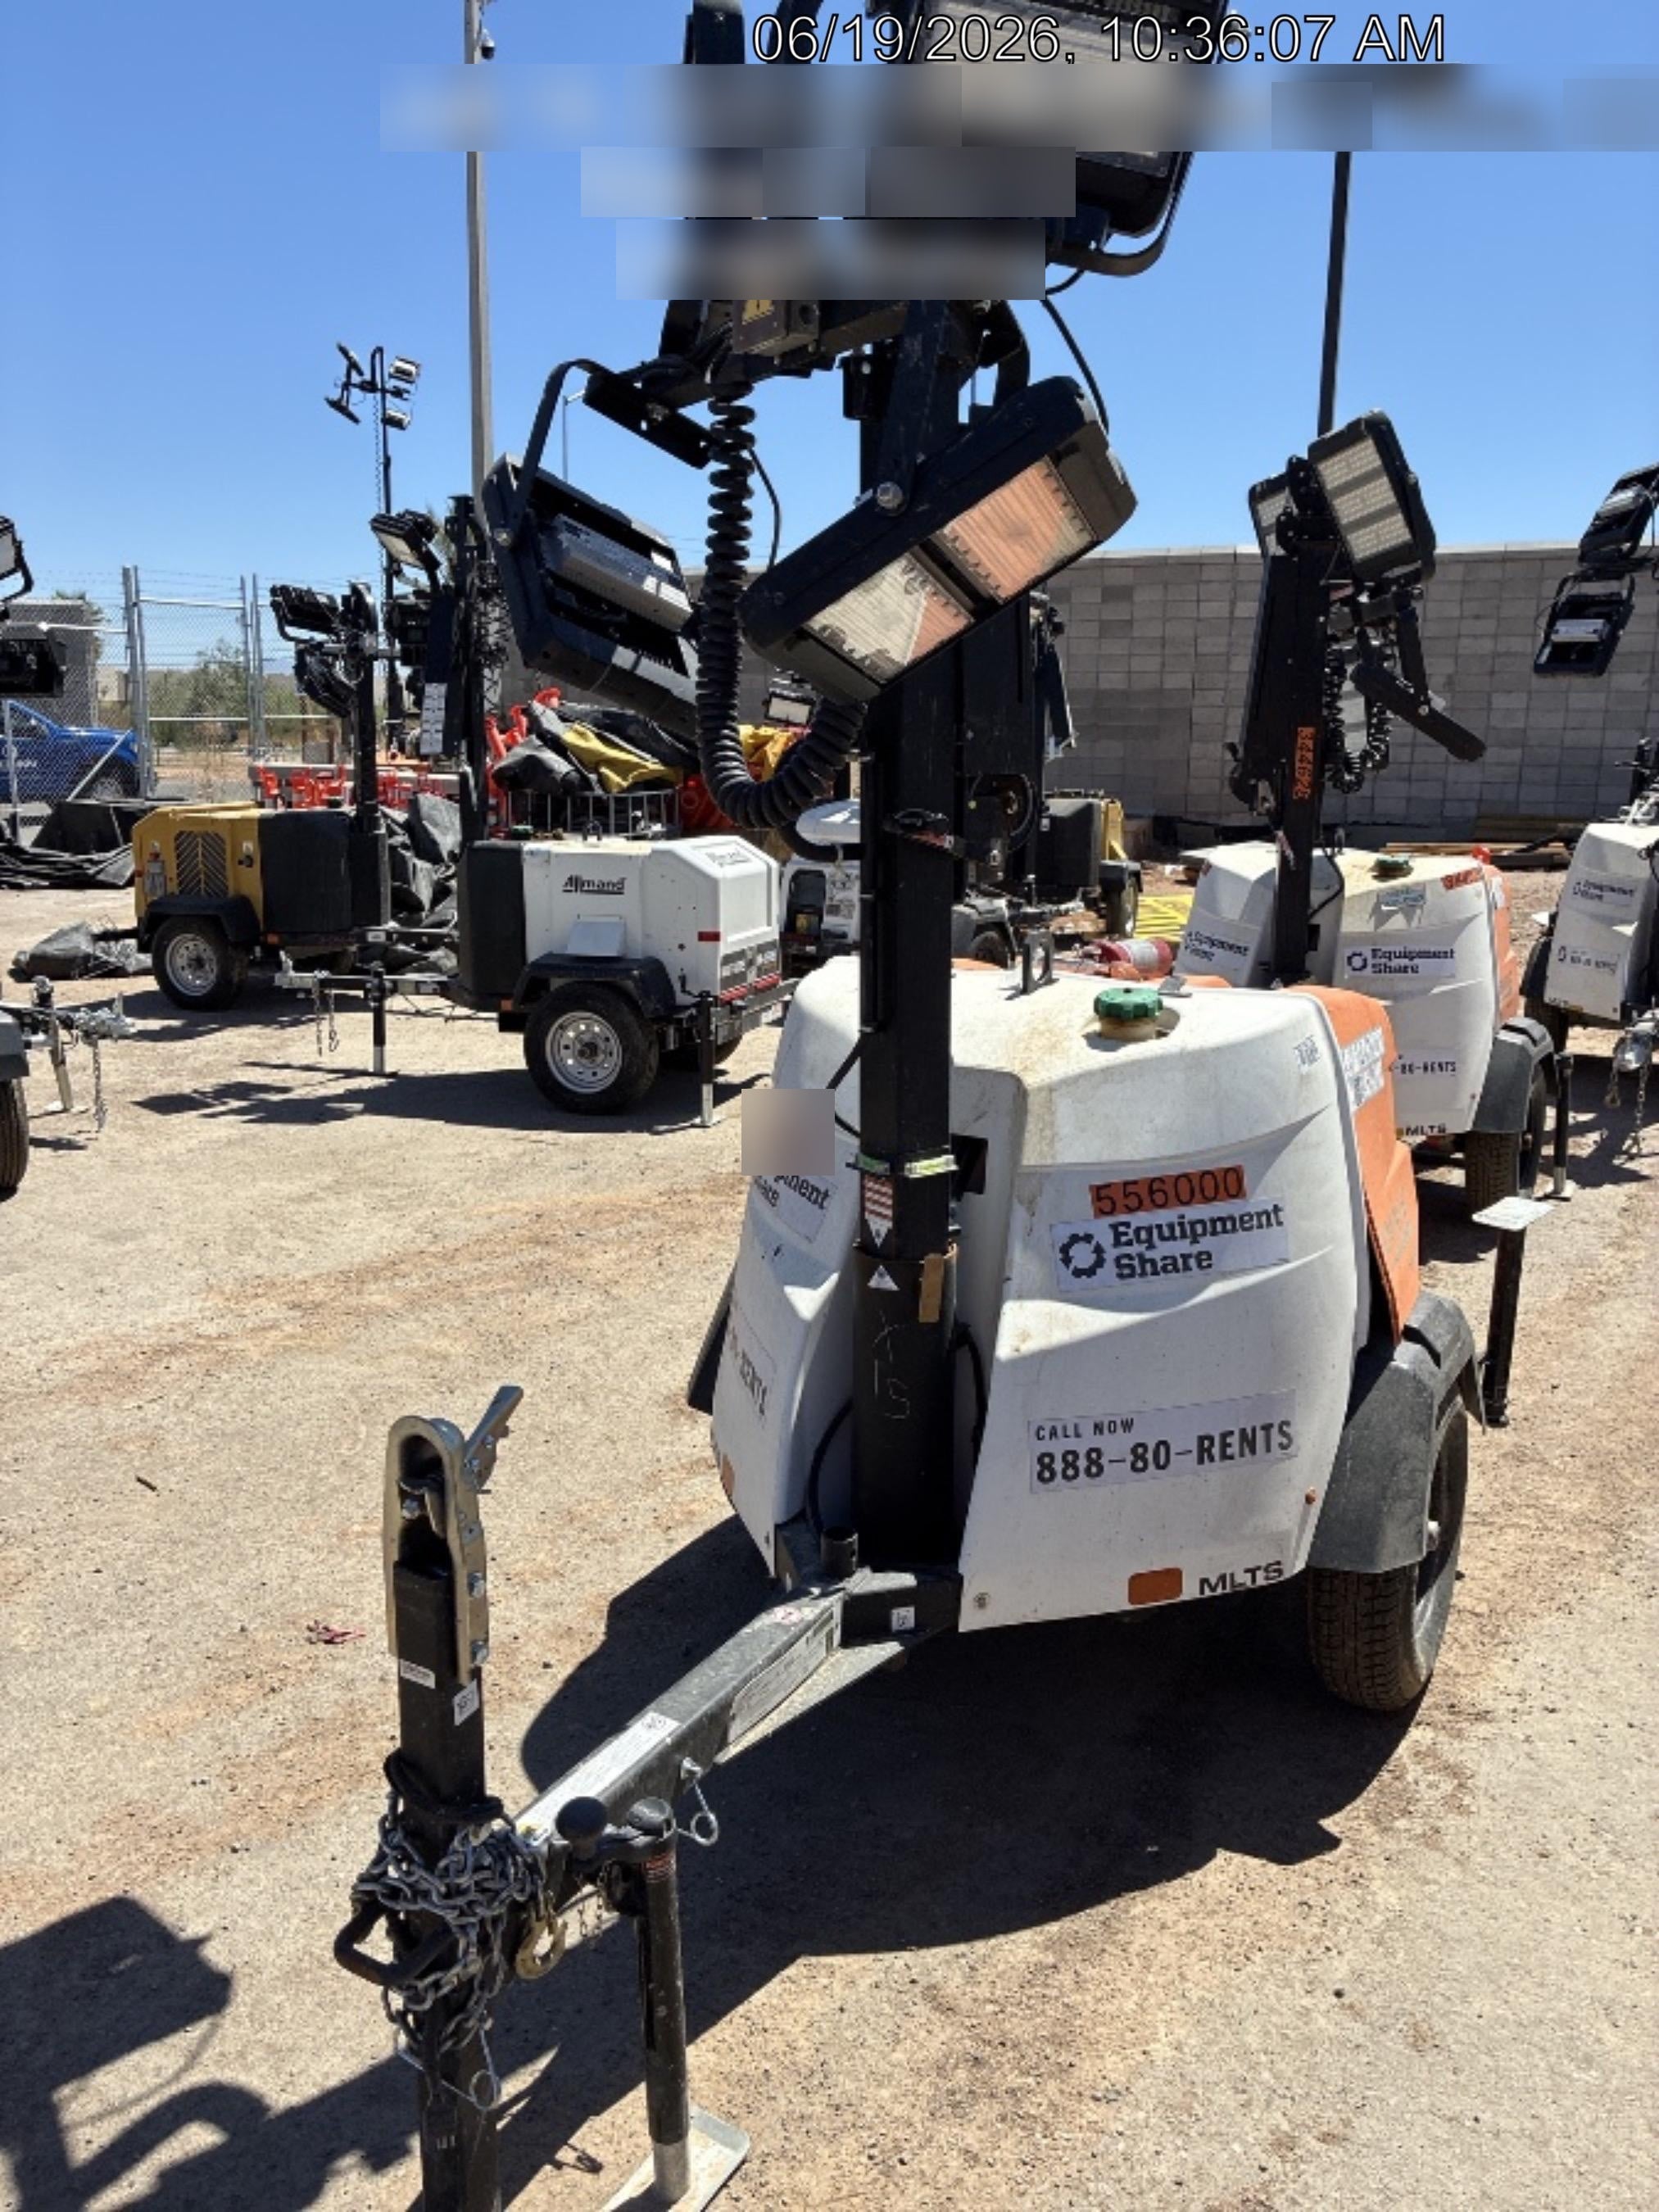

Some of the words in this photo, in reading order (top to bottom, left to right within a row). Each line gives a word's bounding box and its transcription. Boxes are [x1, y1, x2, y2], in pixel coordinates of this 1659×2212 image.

[1371, 946, 1455, 961] Equipment
[1371, 962, 1420, 974] Share
[1095, 1167, 1244, 1215] 556000
[1108, 1203, 1284, 1251] Equipment
[1114, 1249, 1213, 1280] Share
[1036, 1423, 1081, 1441] CALL
[1093, 1418, 1134, 1436] NOW
[1036, 1420, 1294, 1484] 888-80-RENTS
[1199, 1560, 1284, 1596] MLTS
